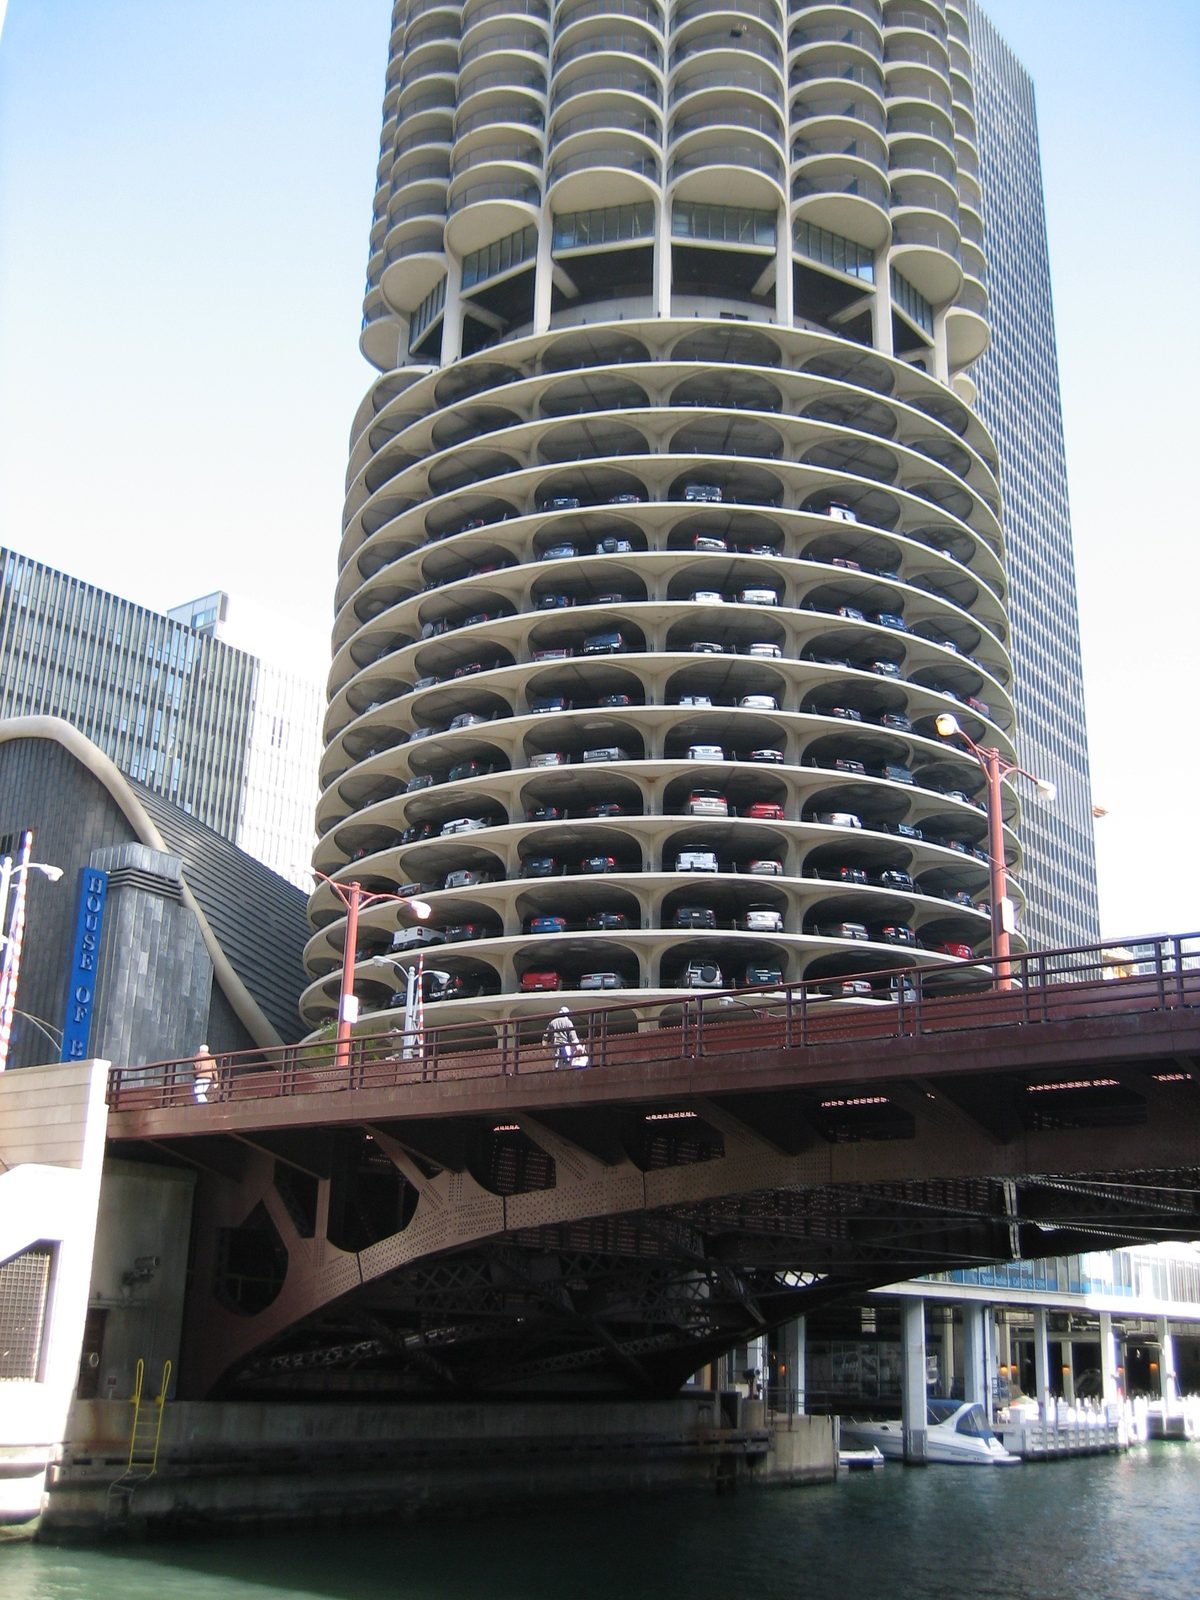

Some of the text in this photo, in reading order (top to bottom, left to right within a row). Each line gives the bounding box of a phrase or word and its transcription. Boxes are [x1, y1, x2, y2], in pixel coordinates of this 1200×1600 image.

[69, 876, 103, 1062] HOUSE OF B
